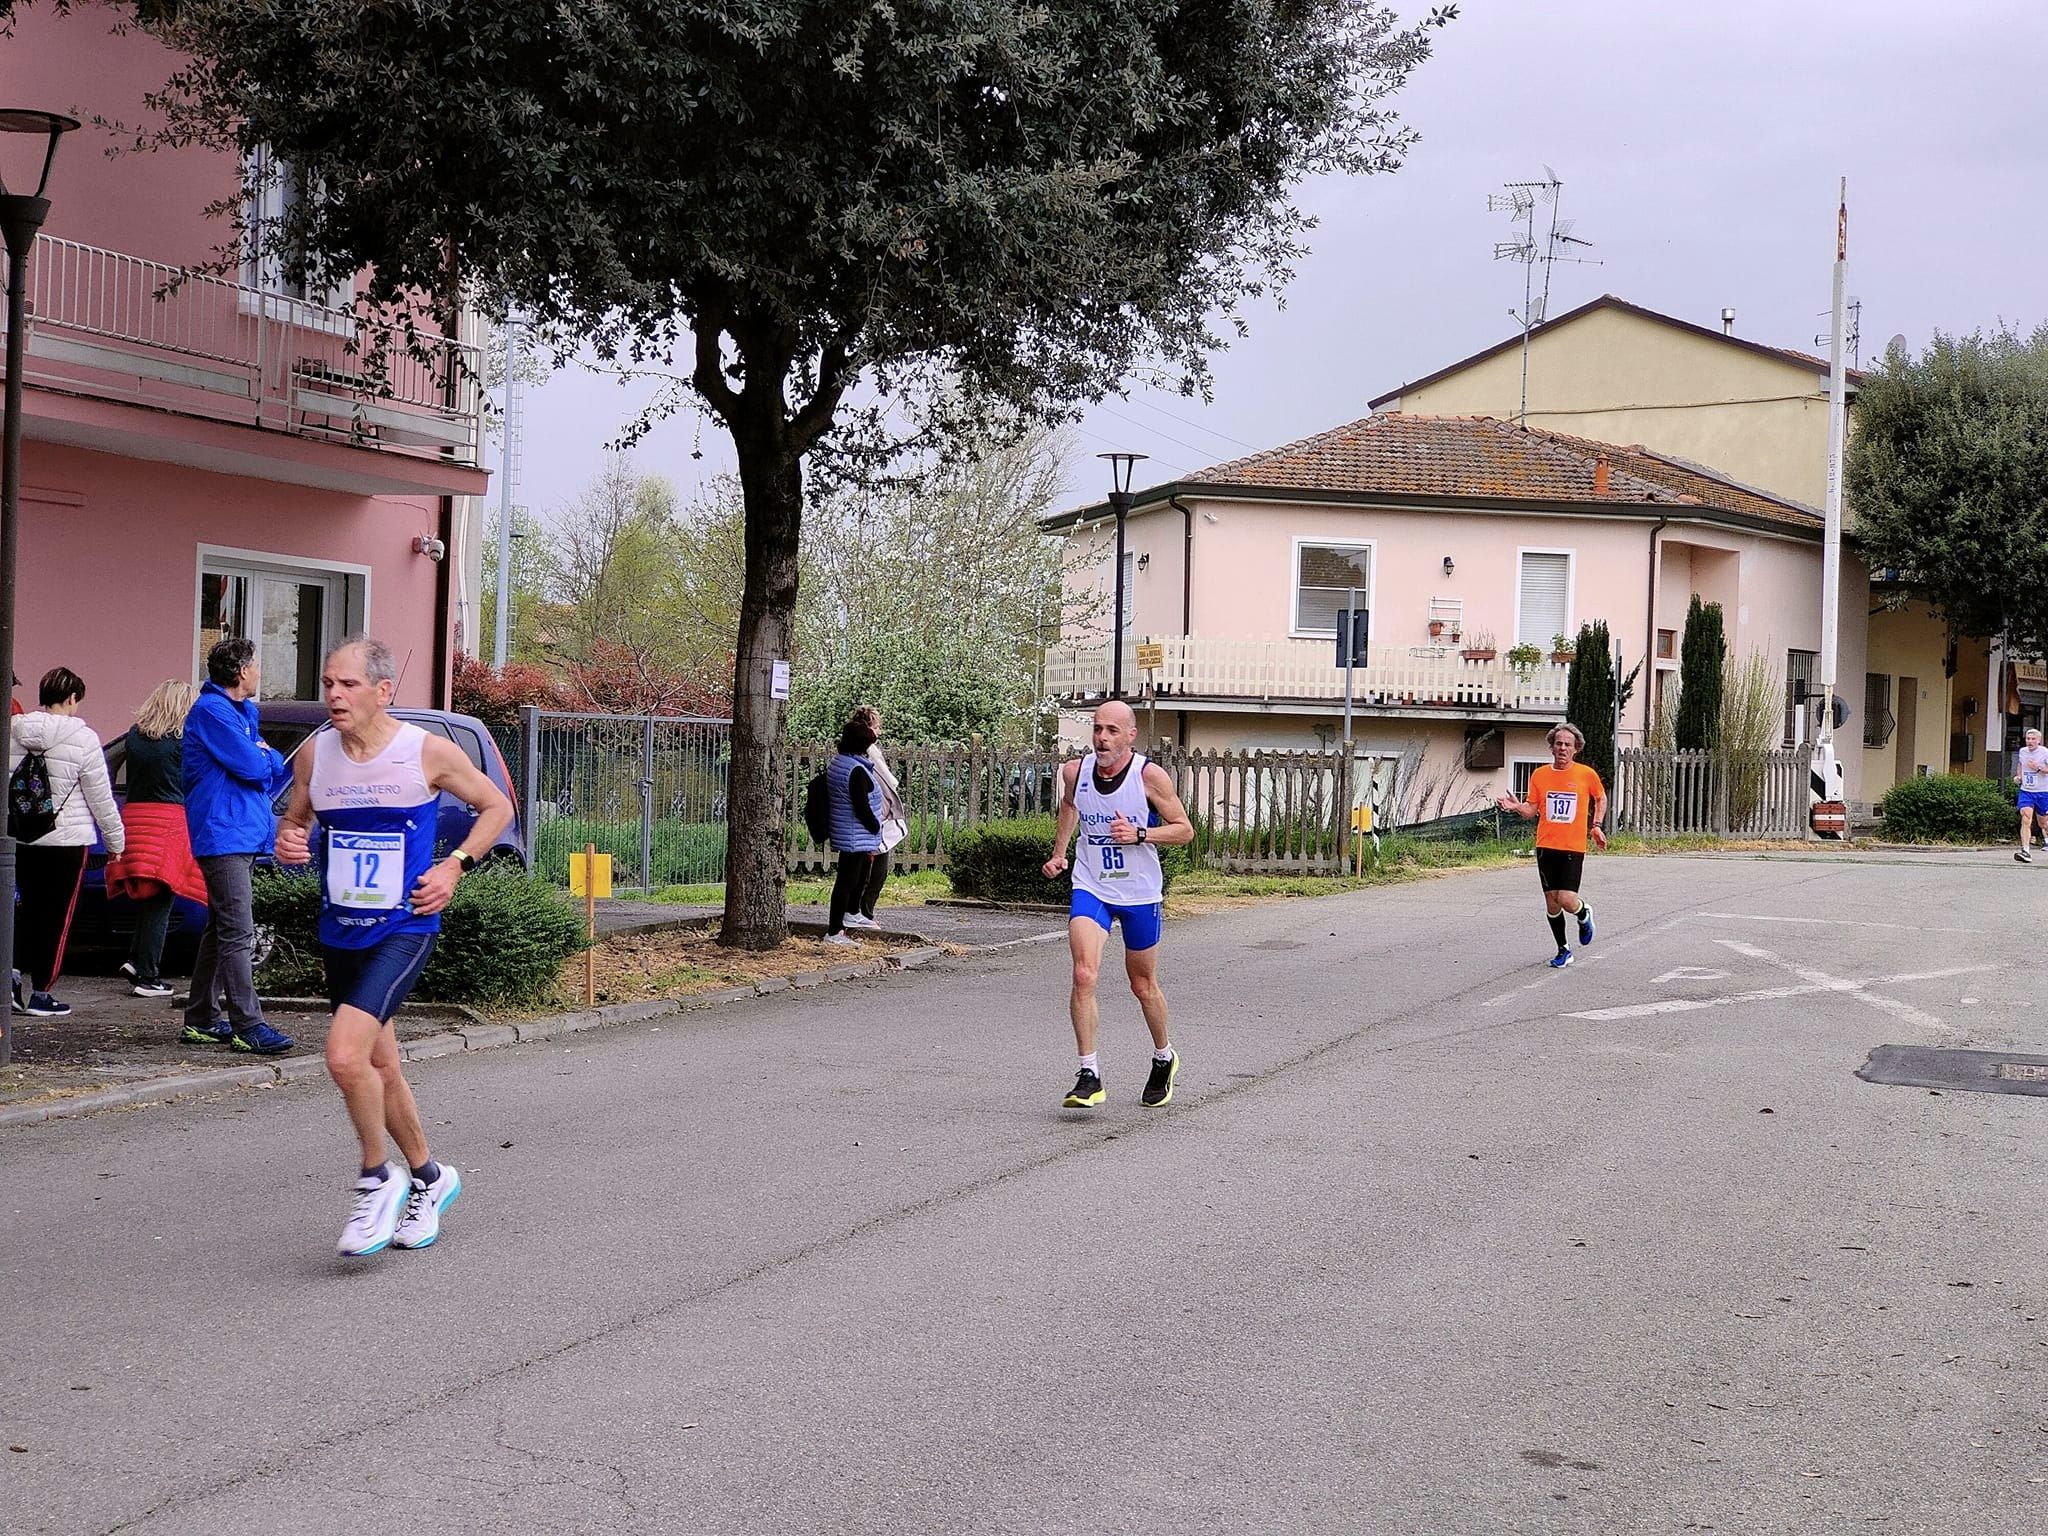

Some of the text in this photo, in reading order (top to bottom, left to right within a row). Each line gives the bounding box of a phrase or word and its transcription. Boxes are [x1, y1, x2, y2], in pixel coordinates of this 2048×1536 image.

[1553, 799, 1571, 815] 137
[1101, 846, 1125, 870] 85
[353, 853, 380, 889] 12
